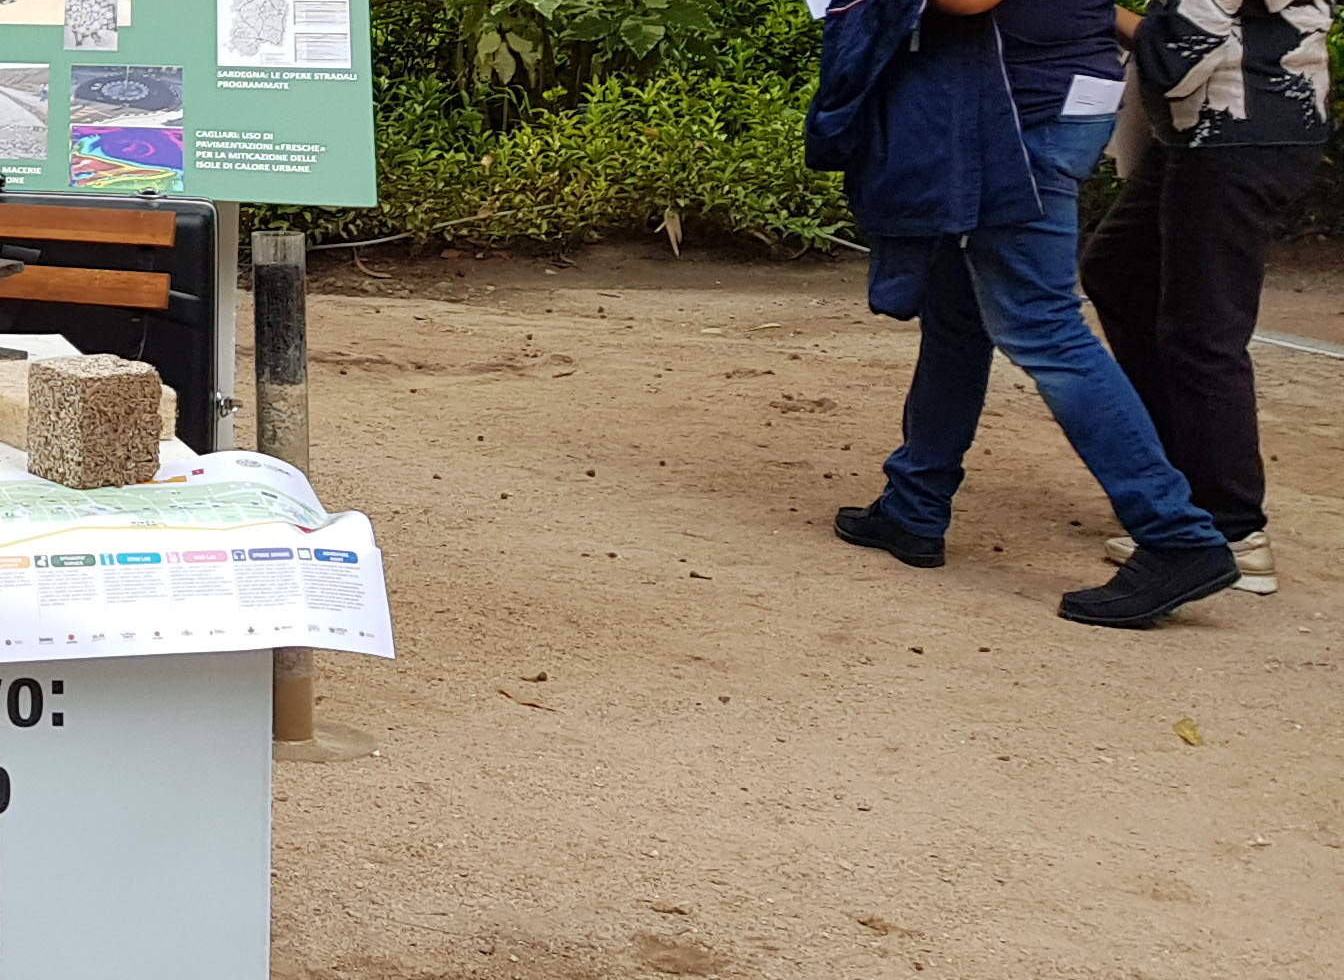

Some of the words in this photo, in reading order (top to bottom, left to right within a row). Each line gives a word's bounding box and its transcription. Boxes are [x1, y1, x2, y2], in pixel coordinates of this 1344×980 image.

[217, 70, 269, 80] SARDEGNA:
[270, 72, 280, 80] LE
[282, 72, 312, 80] OPERE
[314, 72, 358, 80] STRADALI
[217, 80, 290, 90] PROGRAMMATE
[196, 130, 240, 140] CAGLIARI:
[242, 132, 262, 140] USO
[196, 141, 273, 150] PAVIMENTAZIONI
[196, 151, 213, 159] PER
[290, 154, 317, 162] DELLE
[2, 166, 42, 174] MACERIE
[196, 161, 221, 169] ISOLE
[234, 162, 270, 170] CALORE
[272, 164, 310, 172] URBANE
